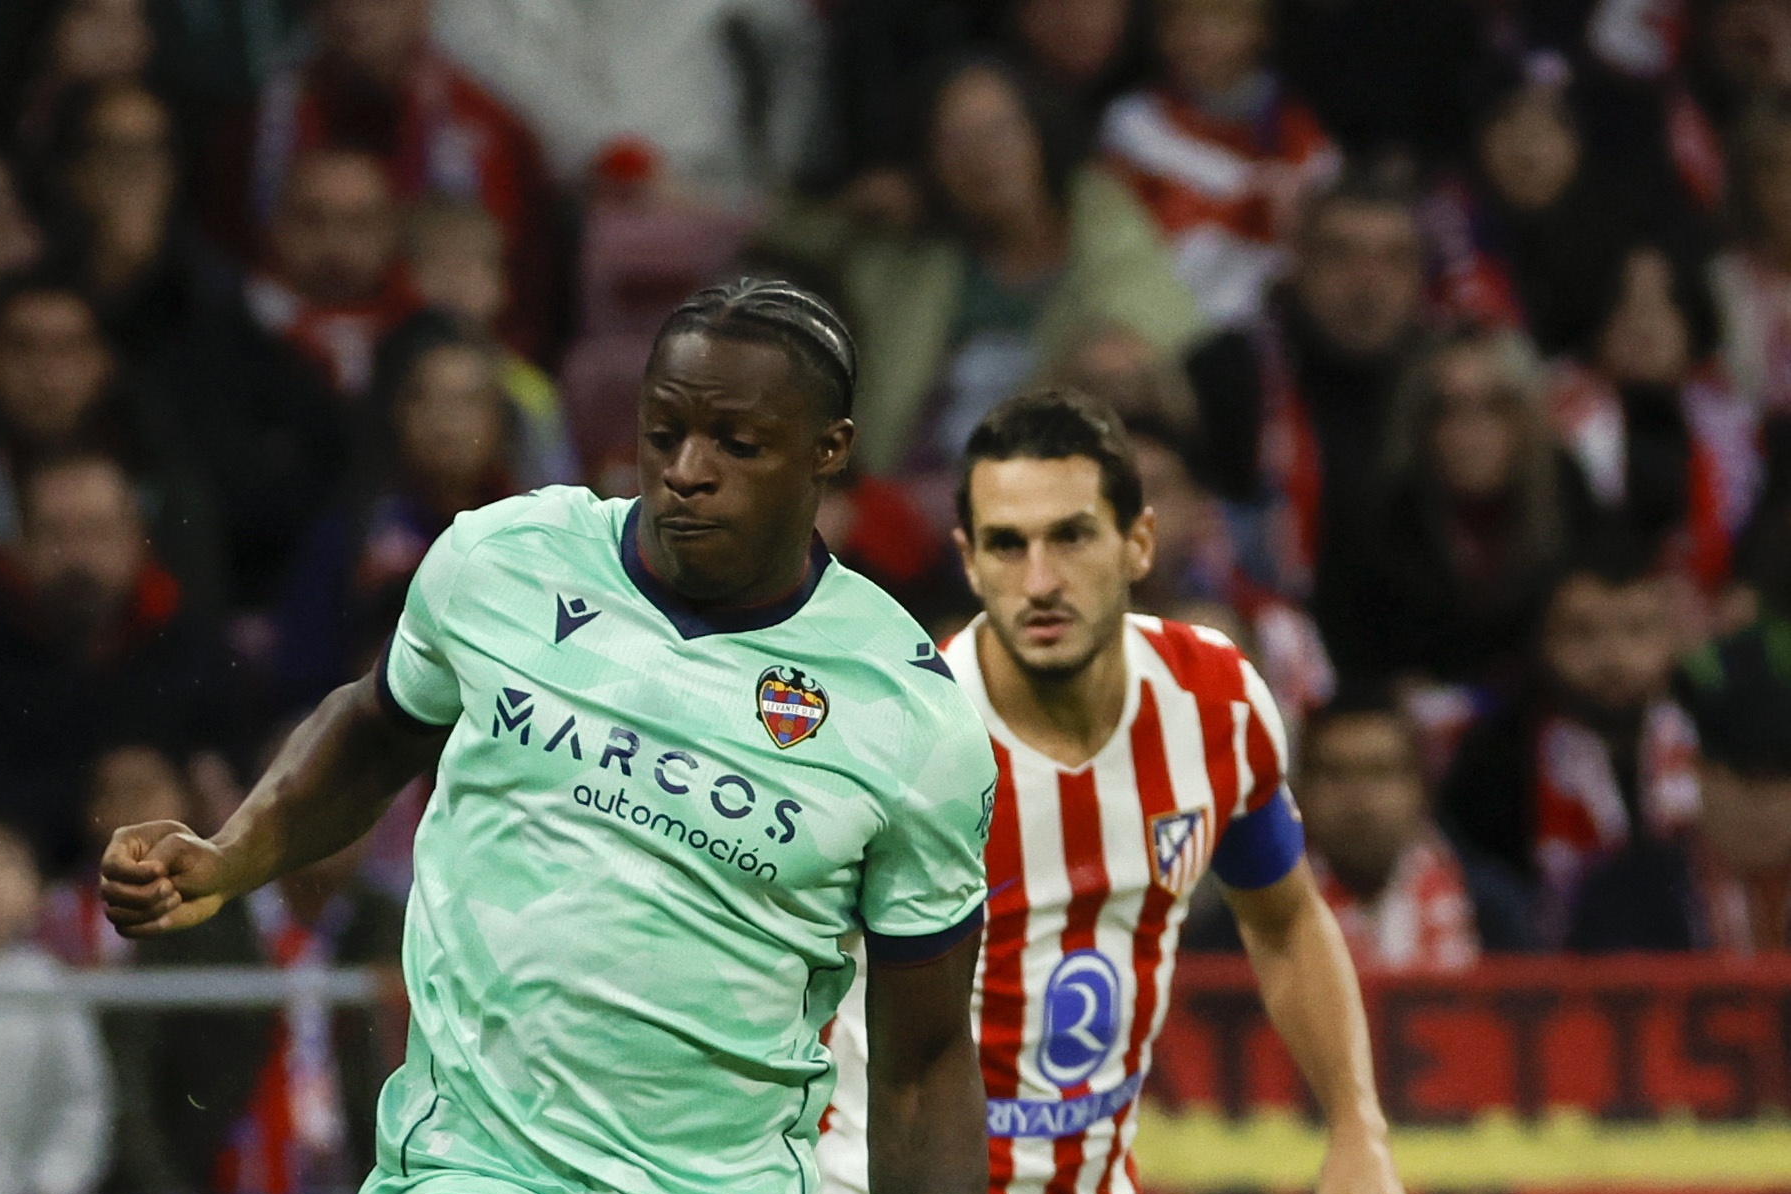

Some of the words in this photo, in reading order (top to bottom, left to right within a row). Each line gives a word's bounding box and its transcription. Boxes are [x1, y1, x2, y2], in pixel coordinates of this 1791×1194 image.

[766, 703, 800, 714] LEVANTE
[492, 687, 803, 843] MARCOS
[573, 784, 777, 881] automoción
